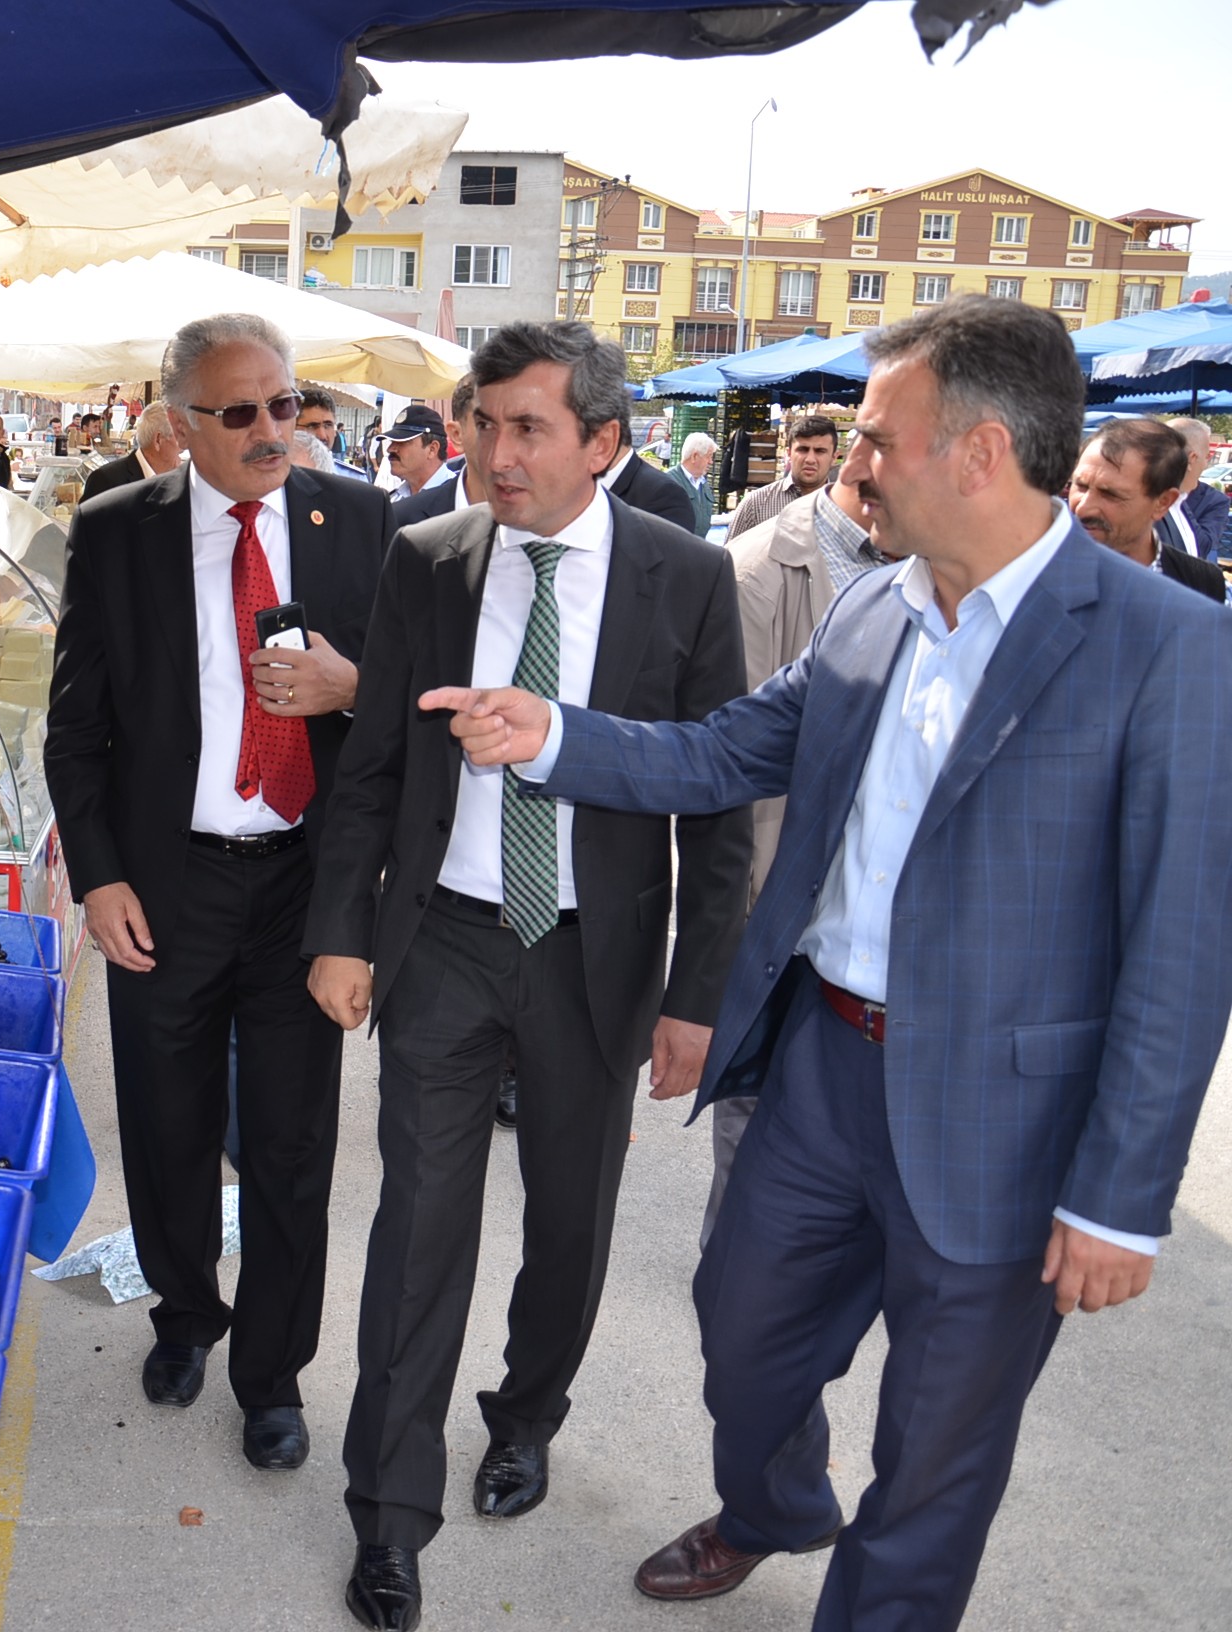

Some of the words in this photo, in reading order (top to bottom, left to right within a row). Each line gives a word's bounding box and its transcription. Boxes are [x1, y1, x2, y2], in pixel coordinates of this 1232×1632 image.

[920, 190, 954, 202] HALİT
[957, 192, 986, 203] USLU
[989, 192, 1031, 206] İNŞAAT
